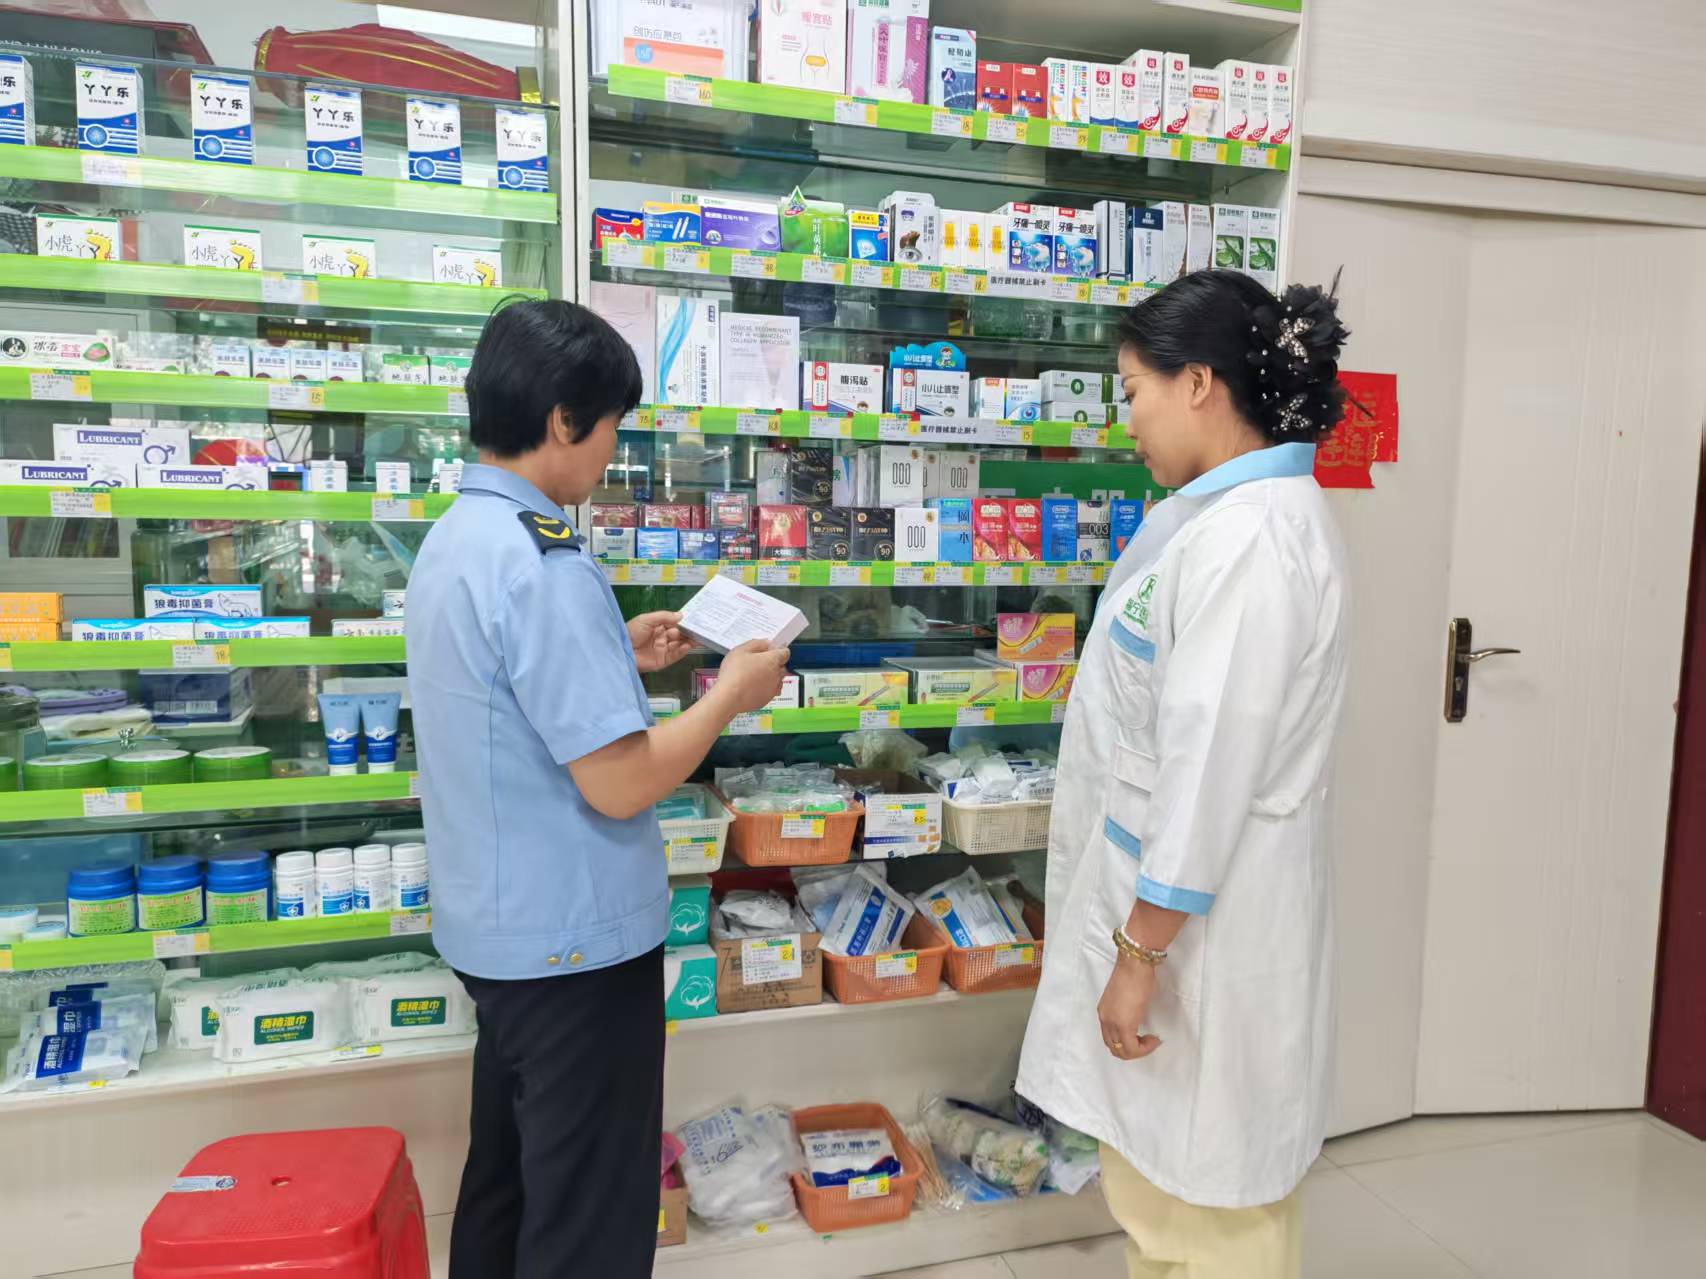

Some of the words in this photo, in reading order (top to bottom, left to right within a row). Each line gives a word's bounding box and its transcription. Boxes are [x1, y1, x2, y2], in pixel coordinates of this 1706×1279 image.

[84, 83, 129, 98] 丫丫乐
[199, 95, 243, 110] 丫丫乐
[313, 107, 354, 122] 丫丫乐
[414, 118, 455, 133] 丫丫乐
[503, 129, 542, 143] 丫丫乐
[1013, 217, 1050, 231] 牙痛一喷灵
[1058, 221, 1095, 235] 牙痛一喷灵
[990, 275, 1046, 287] 医疗器械禁止刷卡
[840, 375, 869, 386] 腹泻贴
[920, 425, 977, 435] 医疗器械禁止刷卡
[79, 432, 141, 445] LUBRICANT
[24, 467, 86, 480] LUBRICANT
[162, 471, 222, 483] LUBRICANT
[1088, 523, 1109, 535] 003
[154, 598, 214, 609] 狼毒抑菌膏
[82, 631, 144, 641] 狼毒抑菌膏
[396, 1000, 440, 1012] 酒精湿巾
[63, 1011, 77, 1033] 湿巾
[260, 1015, 307, 1030] 酒精湿巾
[43, 1036, 62, 1070] 酒精湿巾
